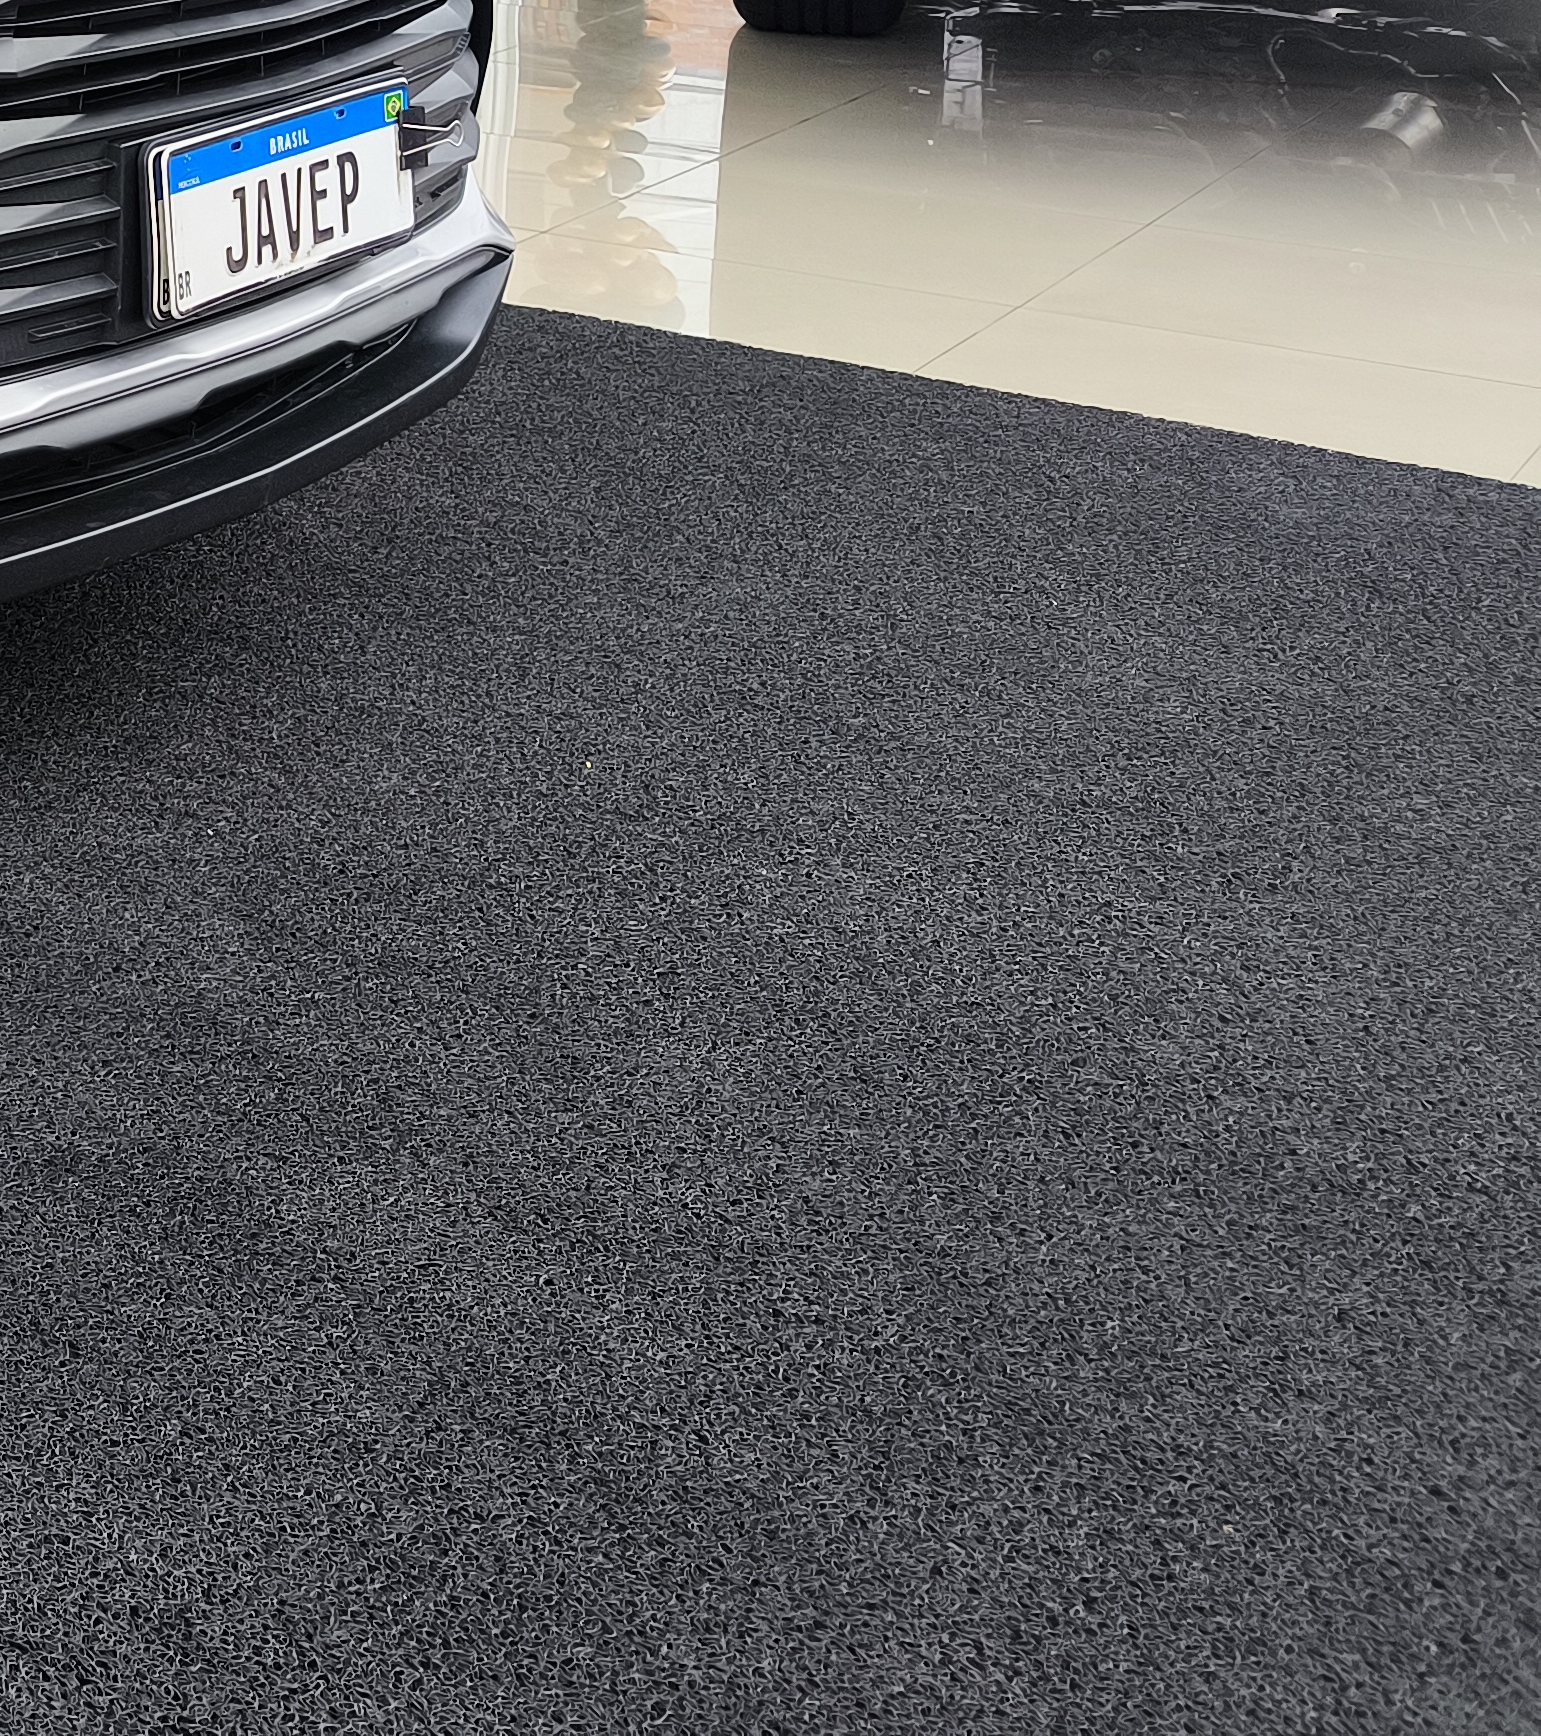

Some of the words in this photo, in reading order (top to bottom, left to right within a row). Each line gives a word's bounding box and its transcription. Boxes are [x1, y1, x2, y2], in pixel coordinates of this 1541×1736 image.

[269, 128, 310, 155] BRASIL
[225, 150, 360, 275] JAVEP
[178, 270, 192, 300] BR
